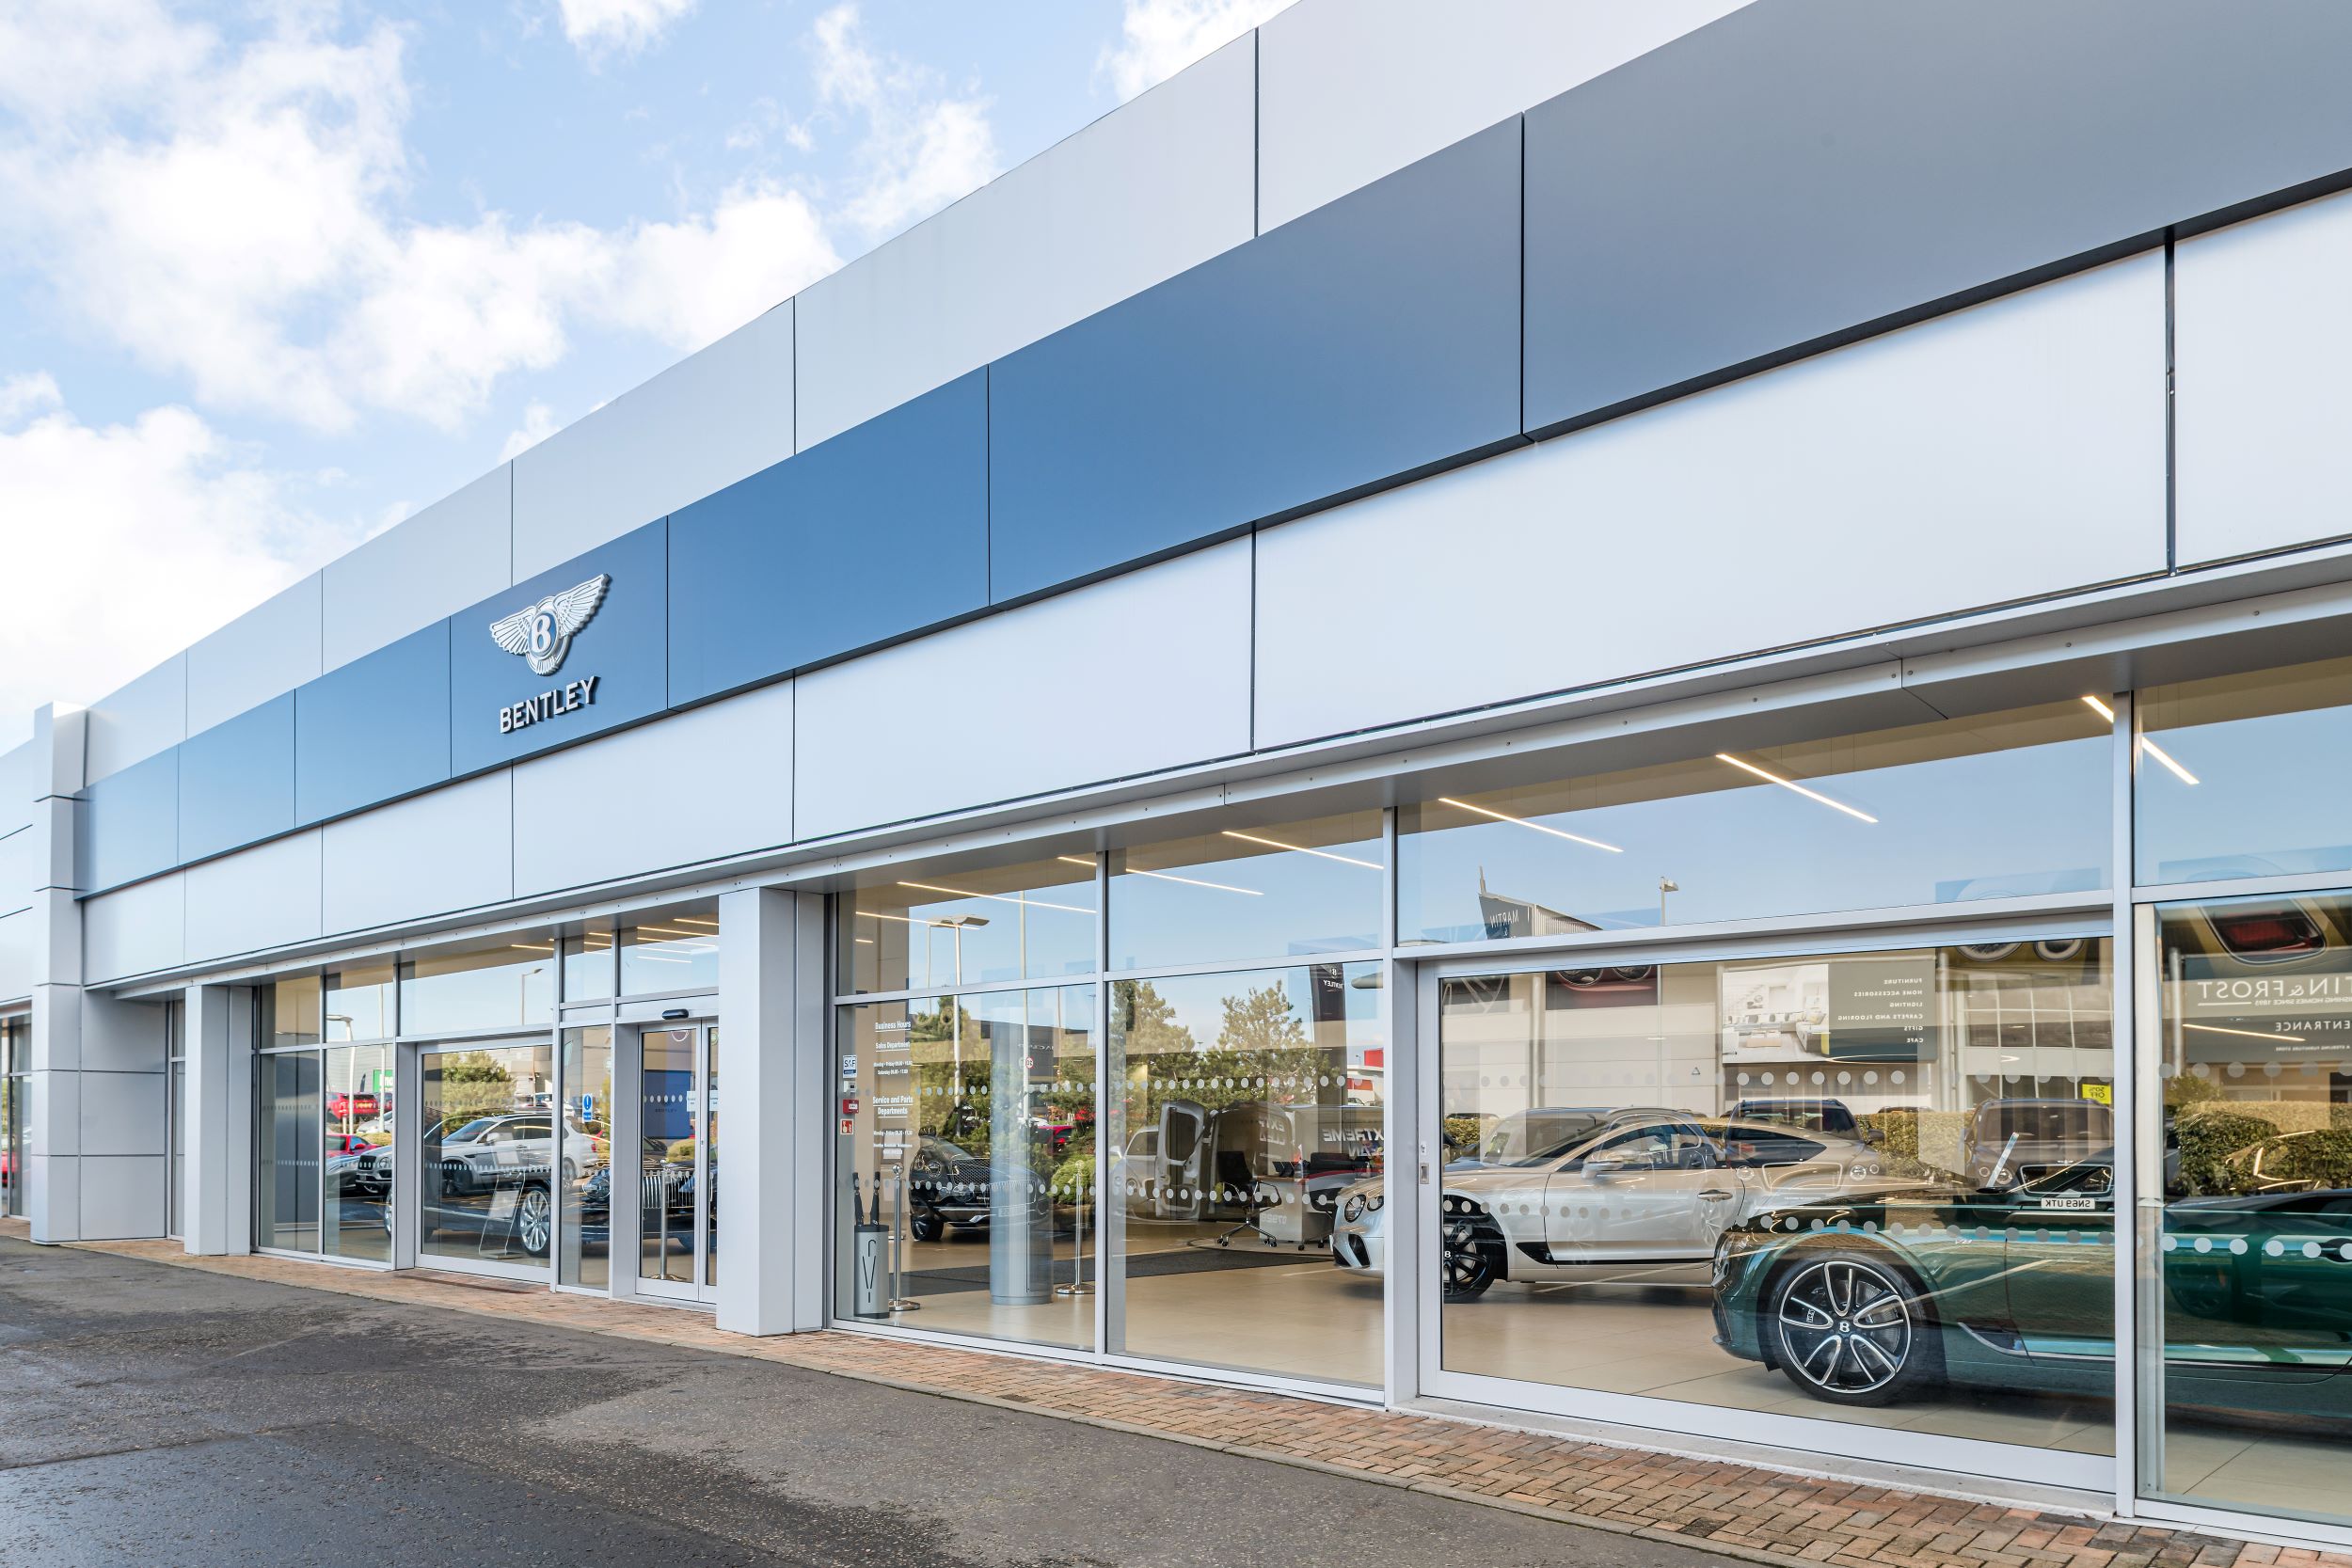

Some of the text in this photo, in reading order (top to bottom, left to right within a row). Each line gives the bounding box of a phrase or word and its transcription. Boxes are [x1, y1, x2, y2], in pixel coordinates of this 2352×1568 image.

[500, 675, 599, 734] BENTLEY
[874, 1020, 911, 1030] Business Hours
[872, 1095, 914, 1104] Service and Parts
[877, 1107, 909, 1116] Departments
[1839, 1322, 1850, 1333] B
